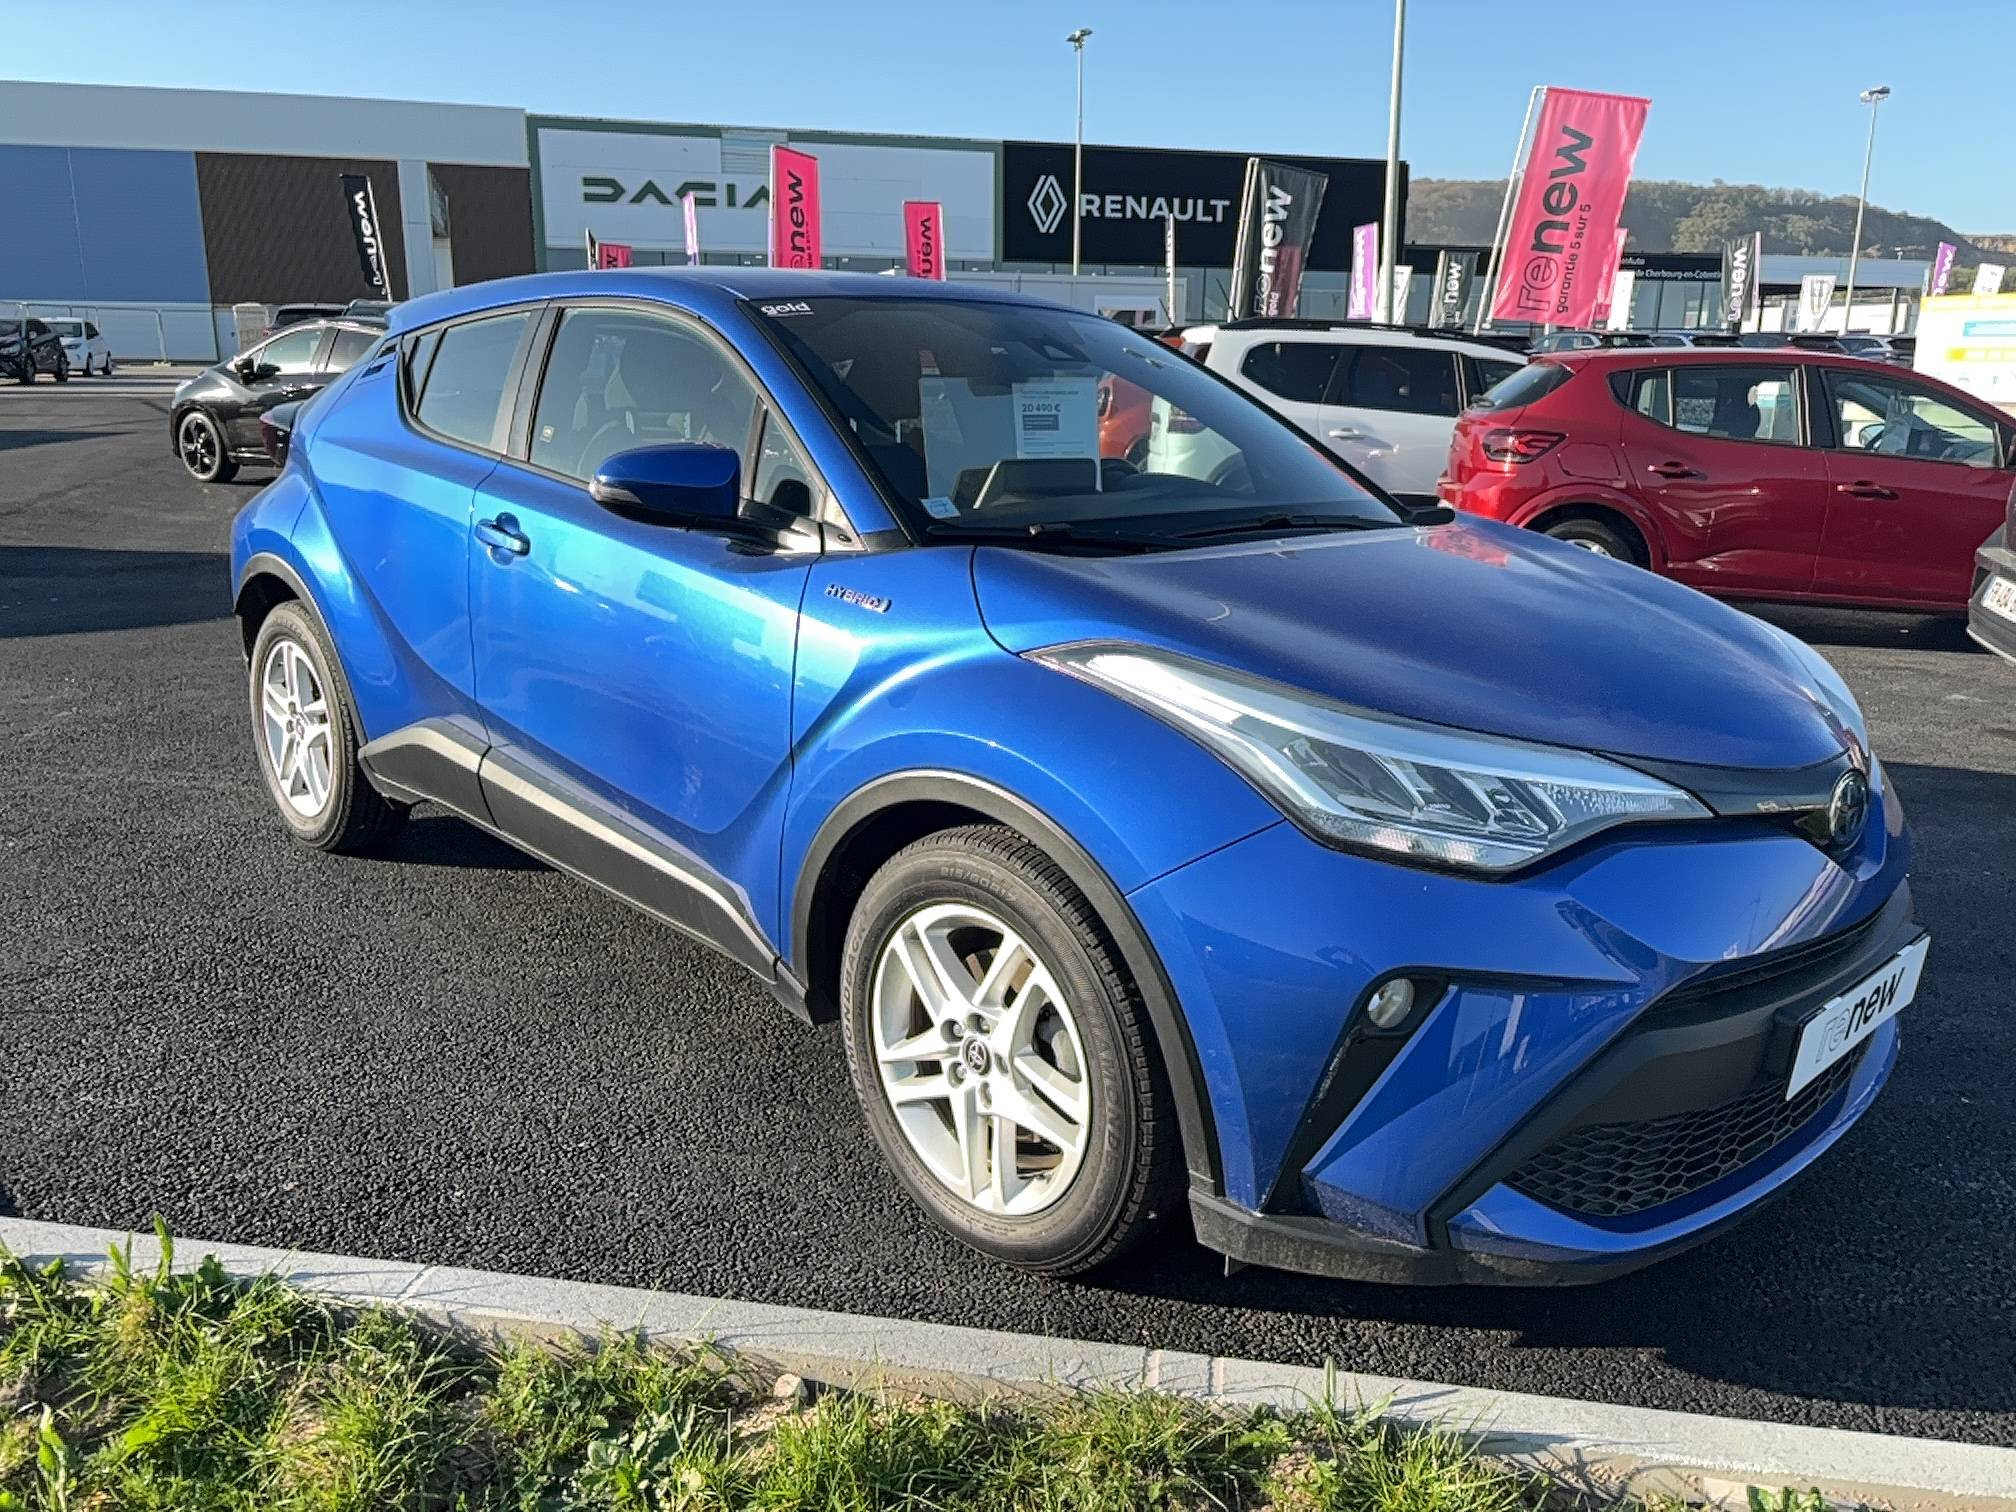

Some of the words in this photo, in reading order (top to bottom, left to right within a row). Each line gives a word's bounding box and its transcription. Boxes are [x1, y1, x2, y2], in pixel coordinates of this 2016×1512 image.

[582, 176, 770, 208] DACIA
[1079, 192, 1230, 223] RENAULT
[786, 169, 806, 269] enew
[1516, 125, 1595, 312] renew
[1579, 203, 1592, 213] 5
[1573, 214, 1591, 240] sur
[1253, 184, 1294, 316] renew
[1570, 241, 1581, 250] 5
[1555, 253, 1578, 314] garantie
[760, 302, 812, 316] gold
[825, 583, 888, 612] HYBRID
[1815, 967, 1906, 1064] renew
